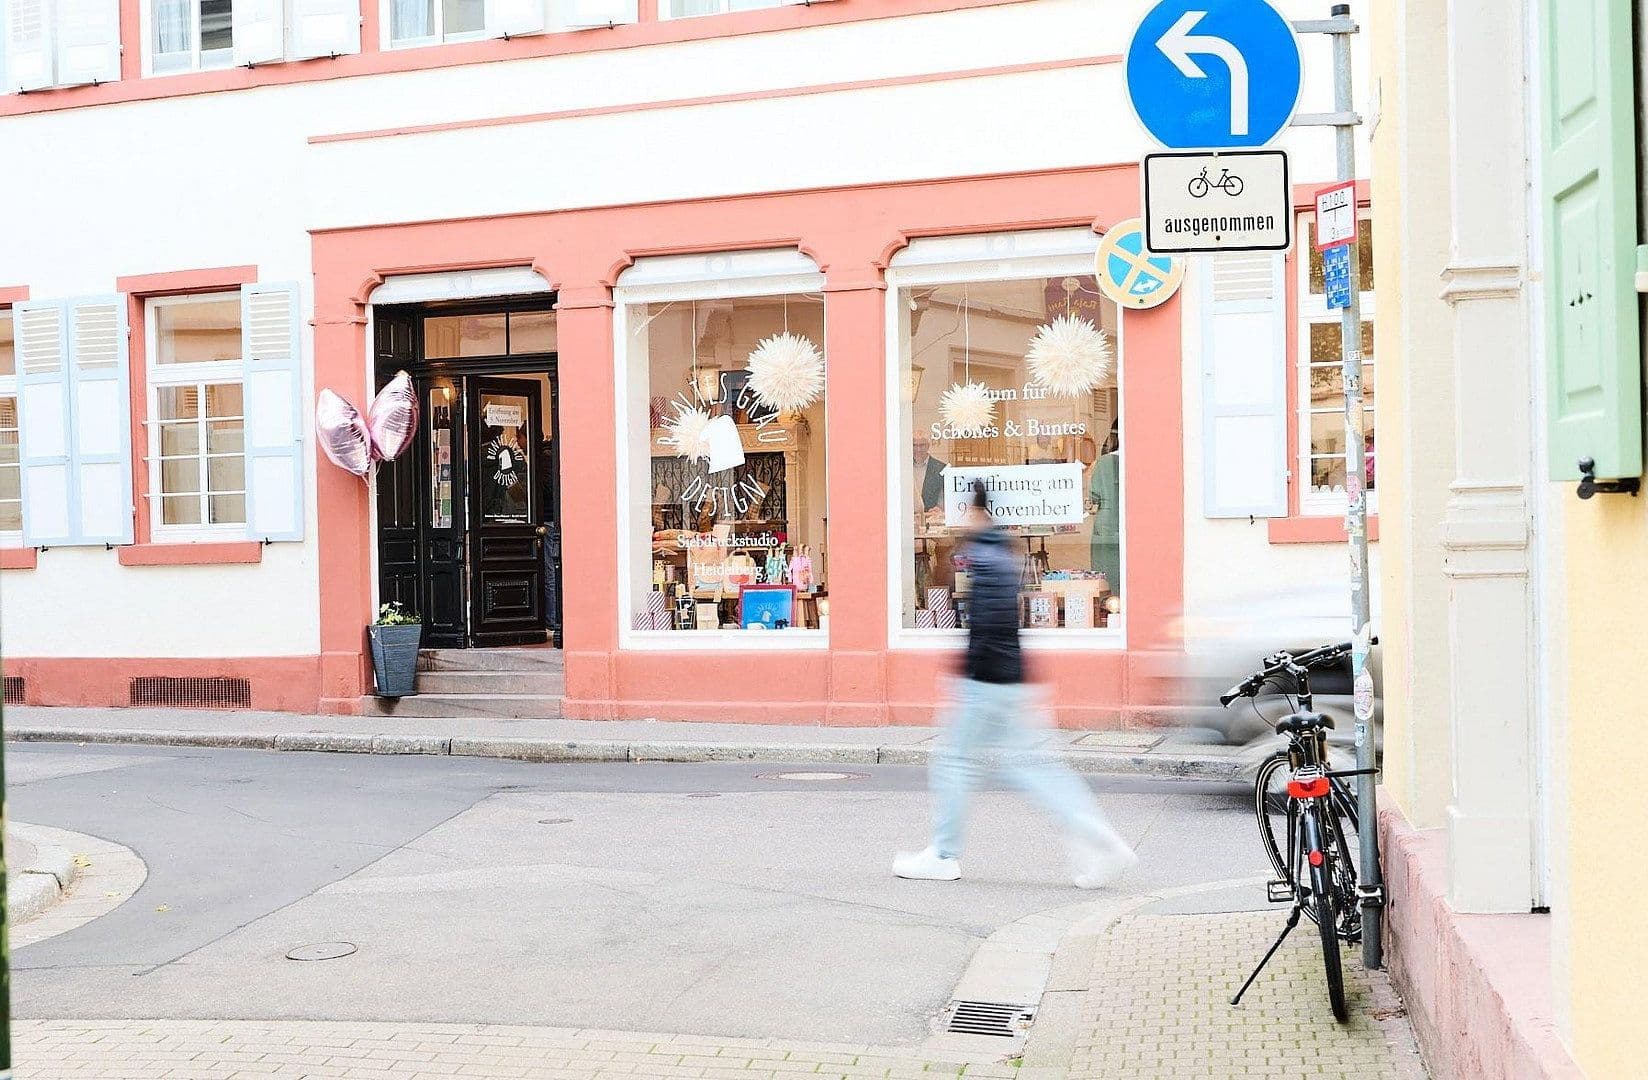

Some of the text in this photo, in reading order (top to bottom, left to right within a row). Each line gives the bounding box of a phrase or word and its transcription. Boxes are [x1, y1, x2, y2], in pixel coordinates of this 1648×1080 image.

[1164, 215, 1274, 236] ausgenommen
[969, 385, 1018, 401] aum
[1003, 419, 1024, 438] &
[1026, 418, 1087, 437] Buntes
[1047, 477, 1074, 490] am
[680, 473, 767, 516] DESIGN
